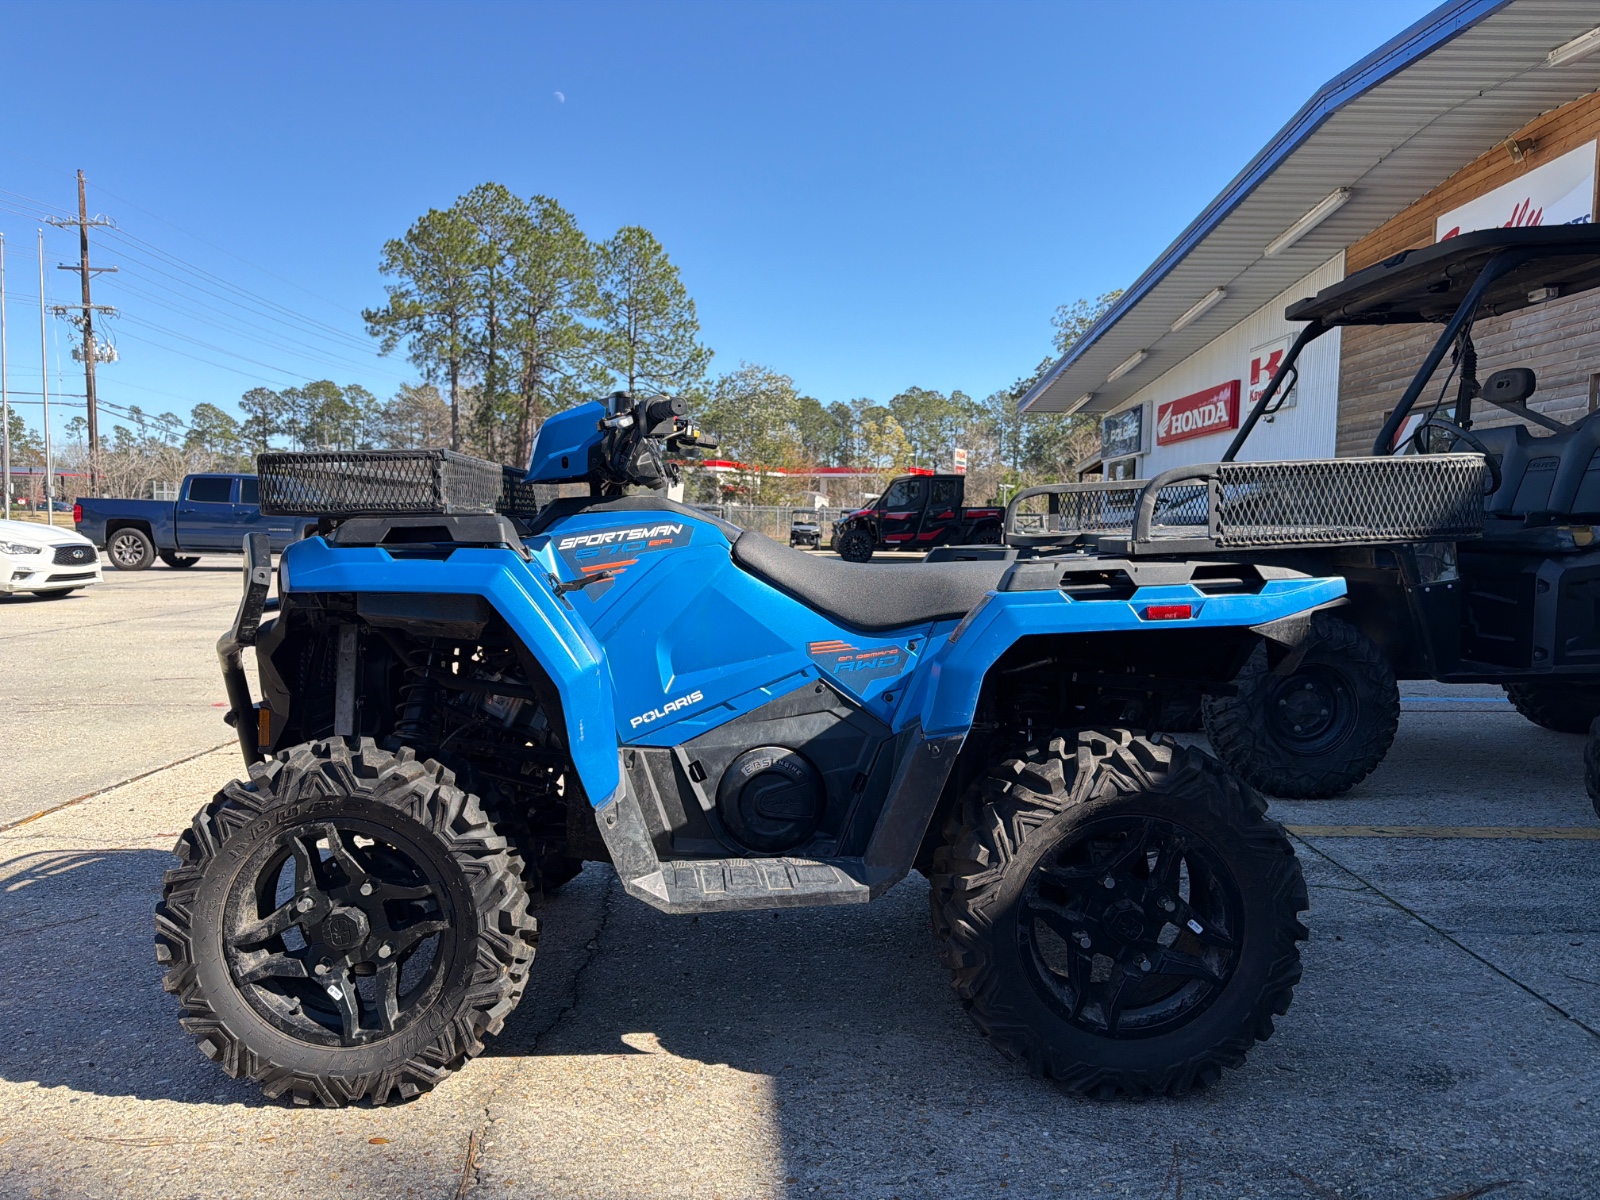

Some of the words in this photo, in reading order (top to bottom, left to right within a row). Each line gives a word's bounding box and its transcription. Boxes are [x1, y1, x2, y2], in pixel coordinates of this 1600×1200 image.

[1171, 401, 1229, 435] HONDA
[558, 524, 683, 550] SPORTSMAN
[575, 540, 647, 559] 570
[648, 538, 673, 547] EFI
[834, 655, 900, 674] AWD
[856, 649, 899, 660] DEMAND
[629, 690, 704, 729] POLARIS
